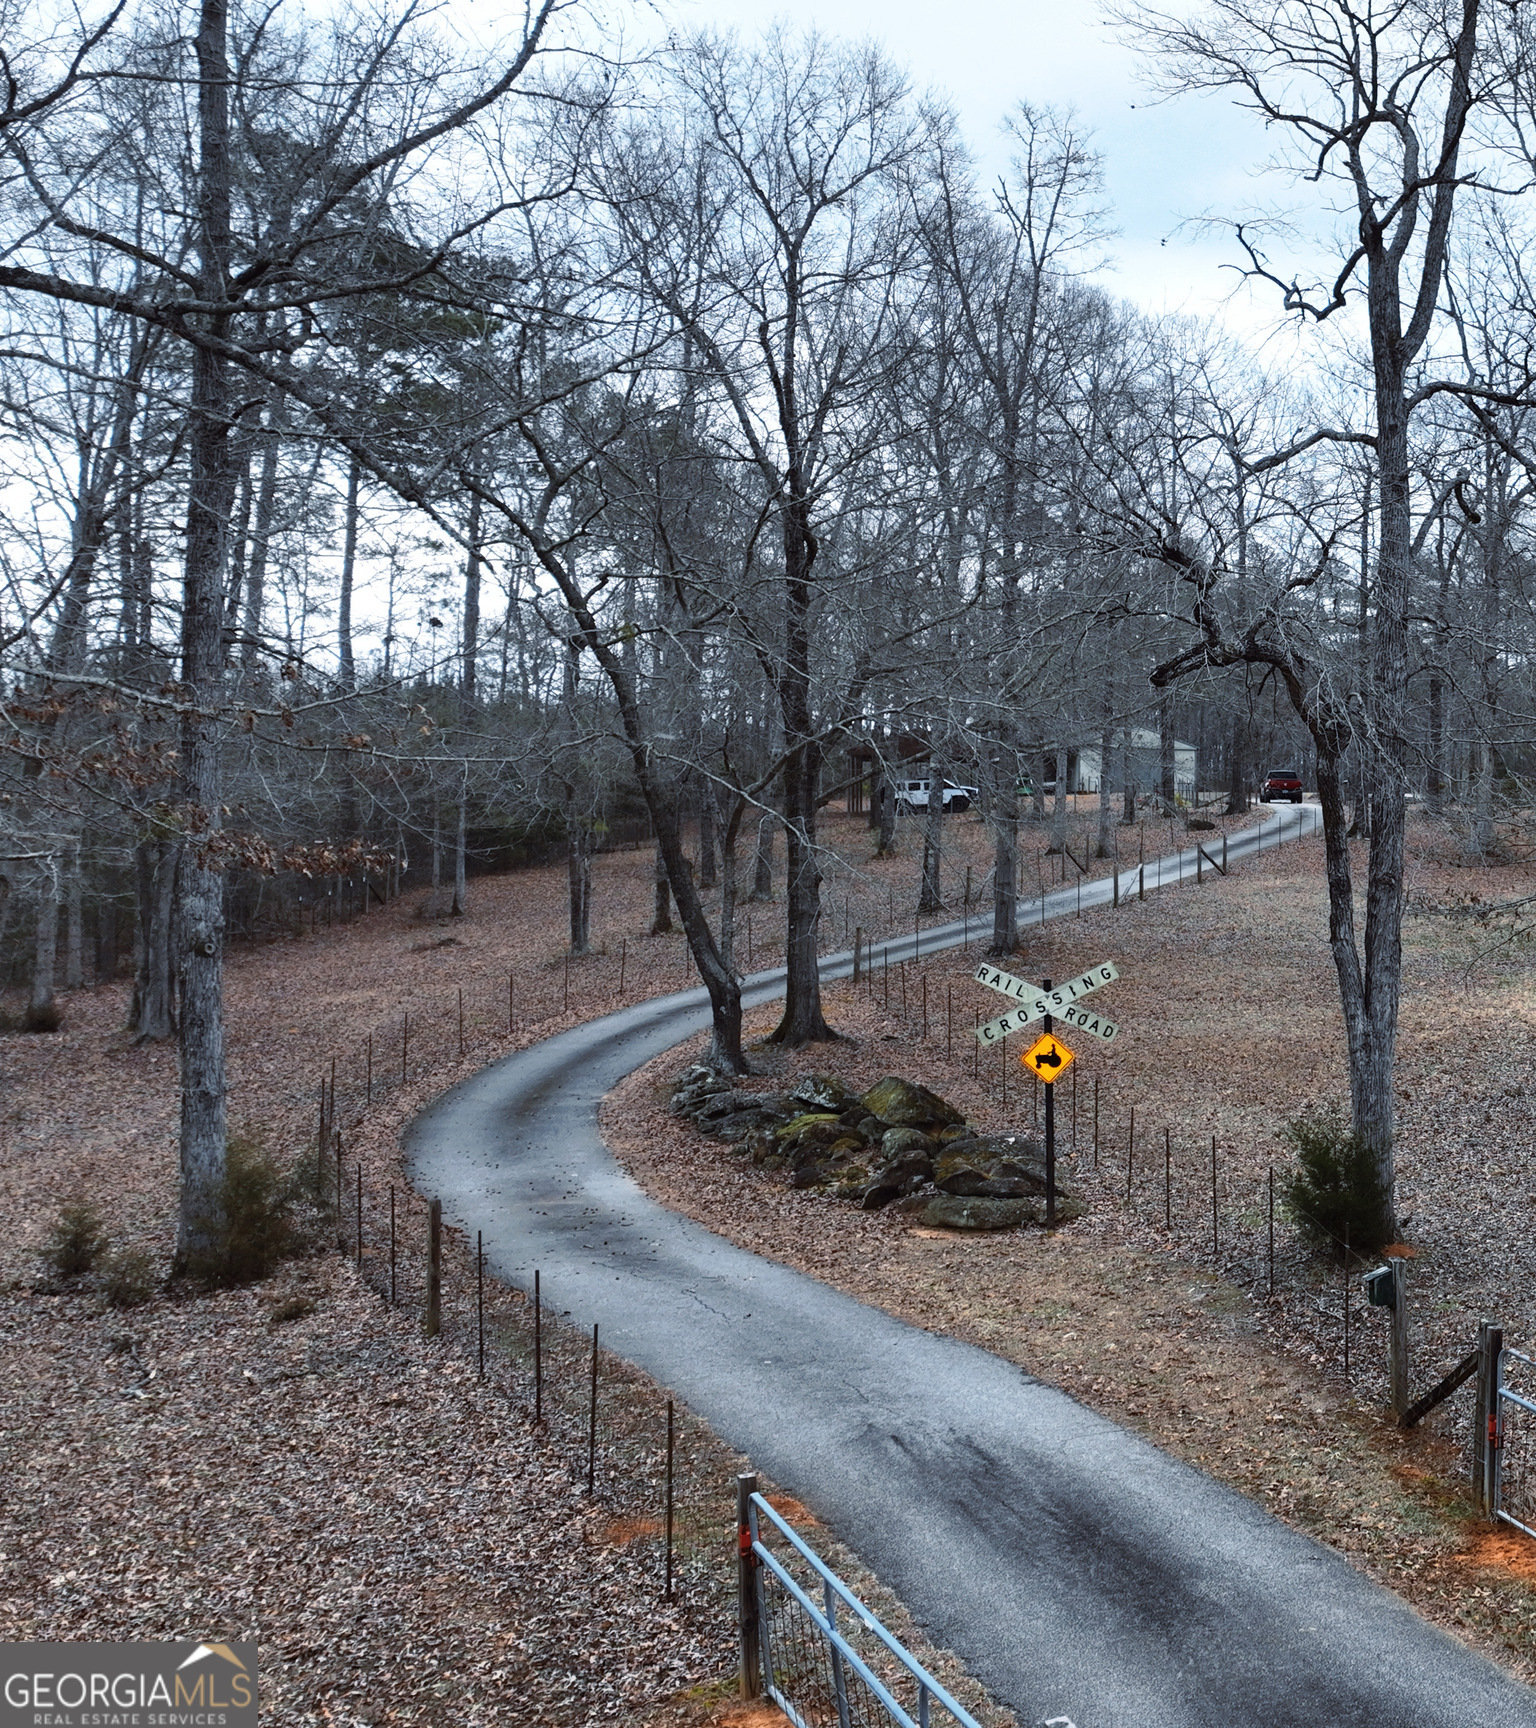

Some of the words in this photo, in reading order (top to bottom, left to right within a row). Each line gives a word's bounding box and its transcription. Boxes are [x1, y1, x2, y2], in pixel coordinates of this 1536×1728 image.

[977, 967, 1024, 998] RAIL
[1065, 1007, 1114, 1038] ROAD
[983, 967, 1112, 1040] CROSSING
